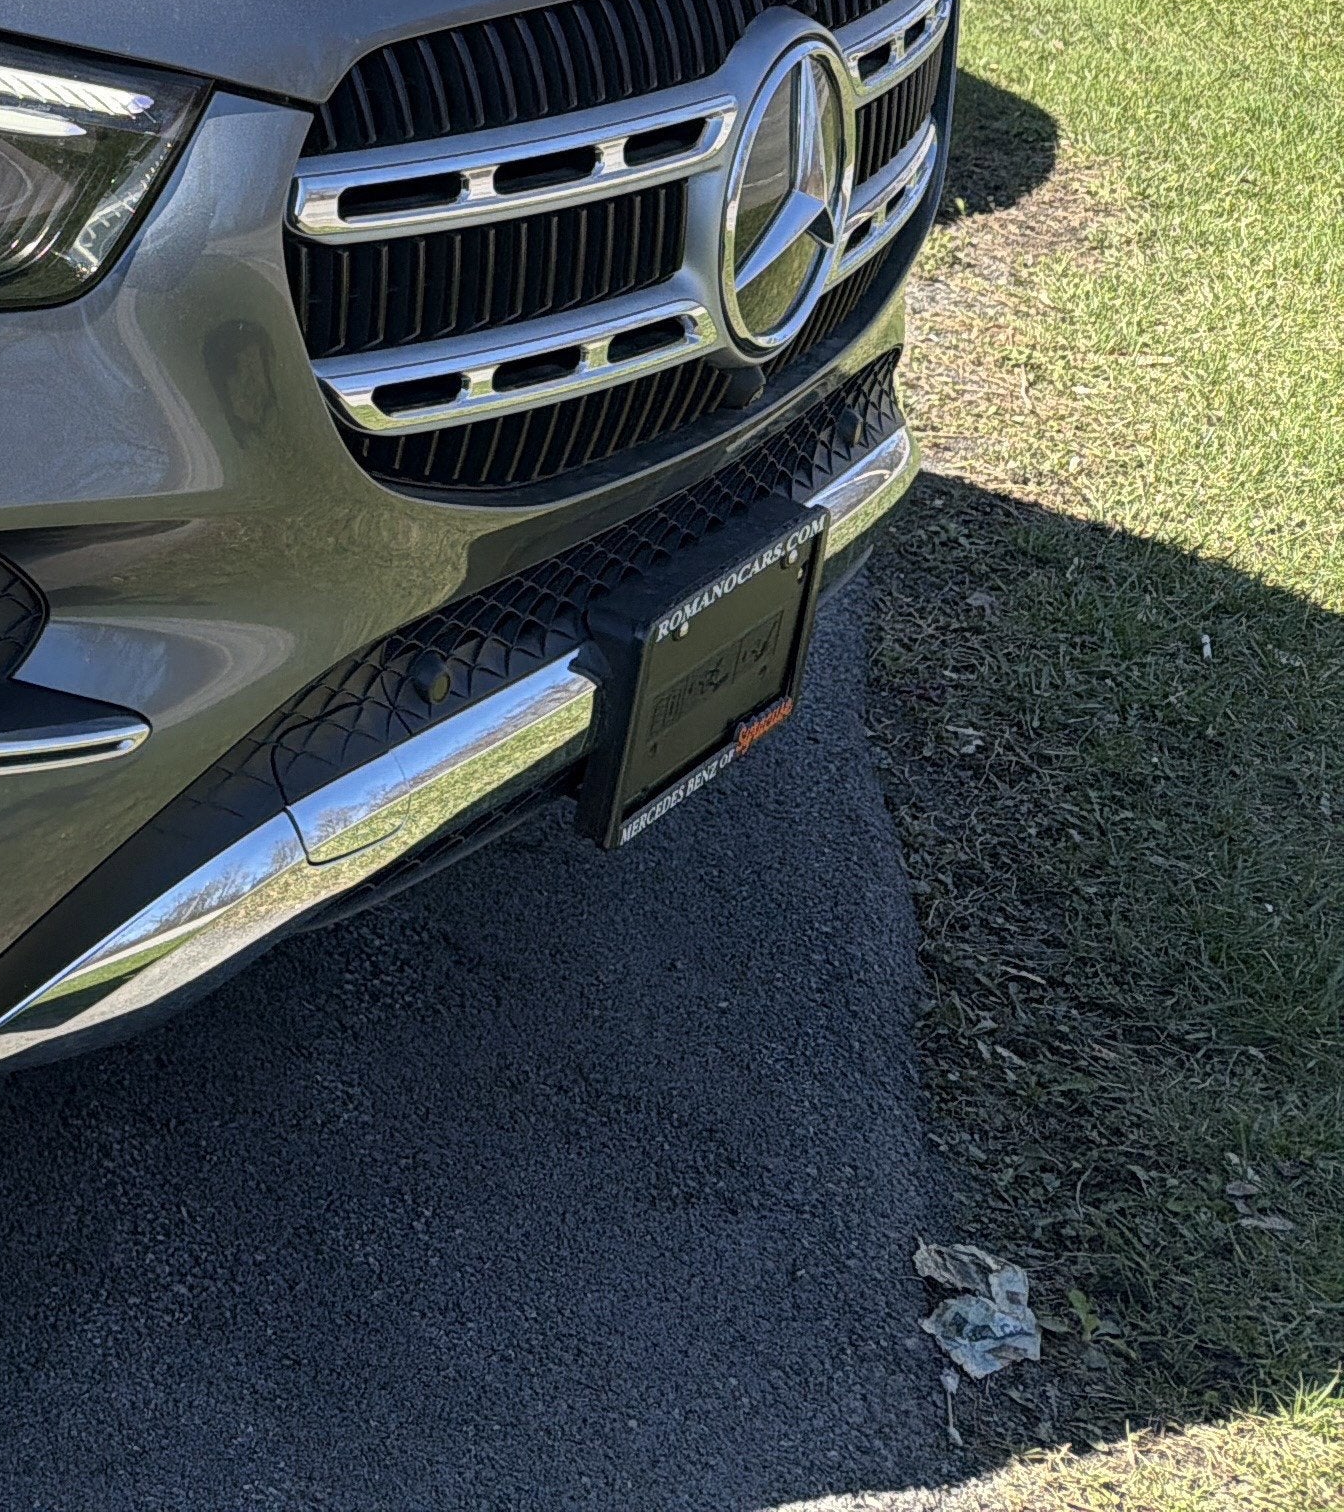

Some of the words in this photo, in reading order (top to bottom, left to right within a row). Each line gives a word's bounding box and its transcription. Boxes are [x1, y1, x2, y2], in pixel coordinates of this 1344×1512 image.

[655, 514, 826, 644] ROMANOCARS.COM
[620, 784, 686, 847] MERCEDES
[686, 759, 718, 797] BENZ
[719, 748, 736, 769] OF
